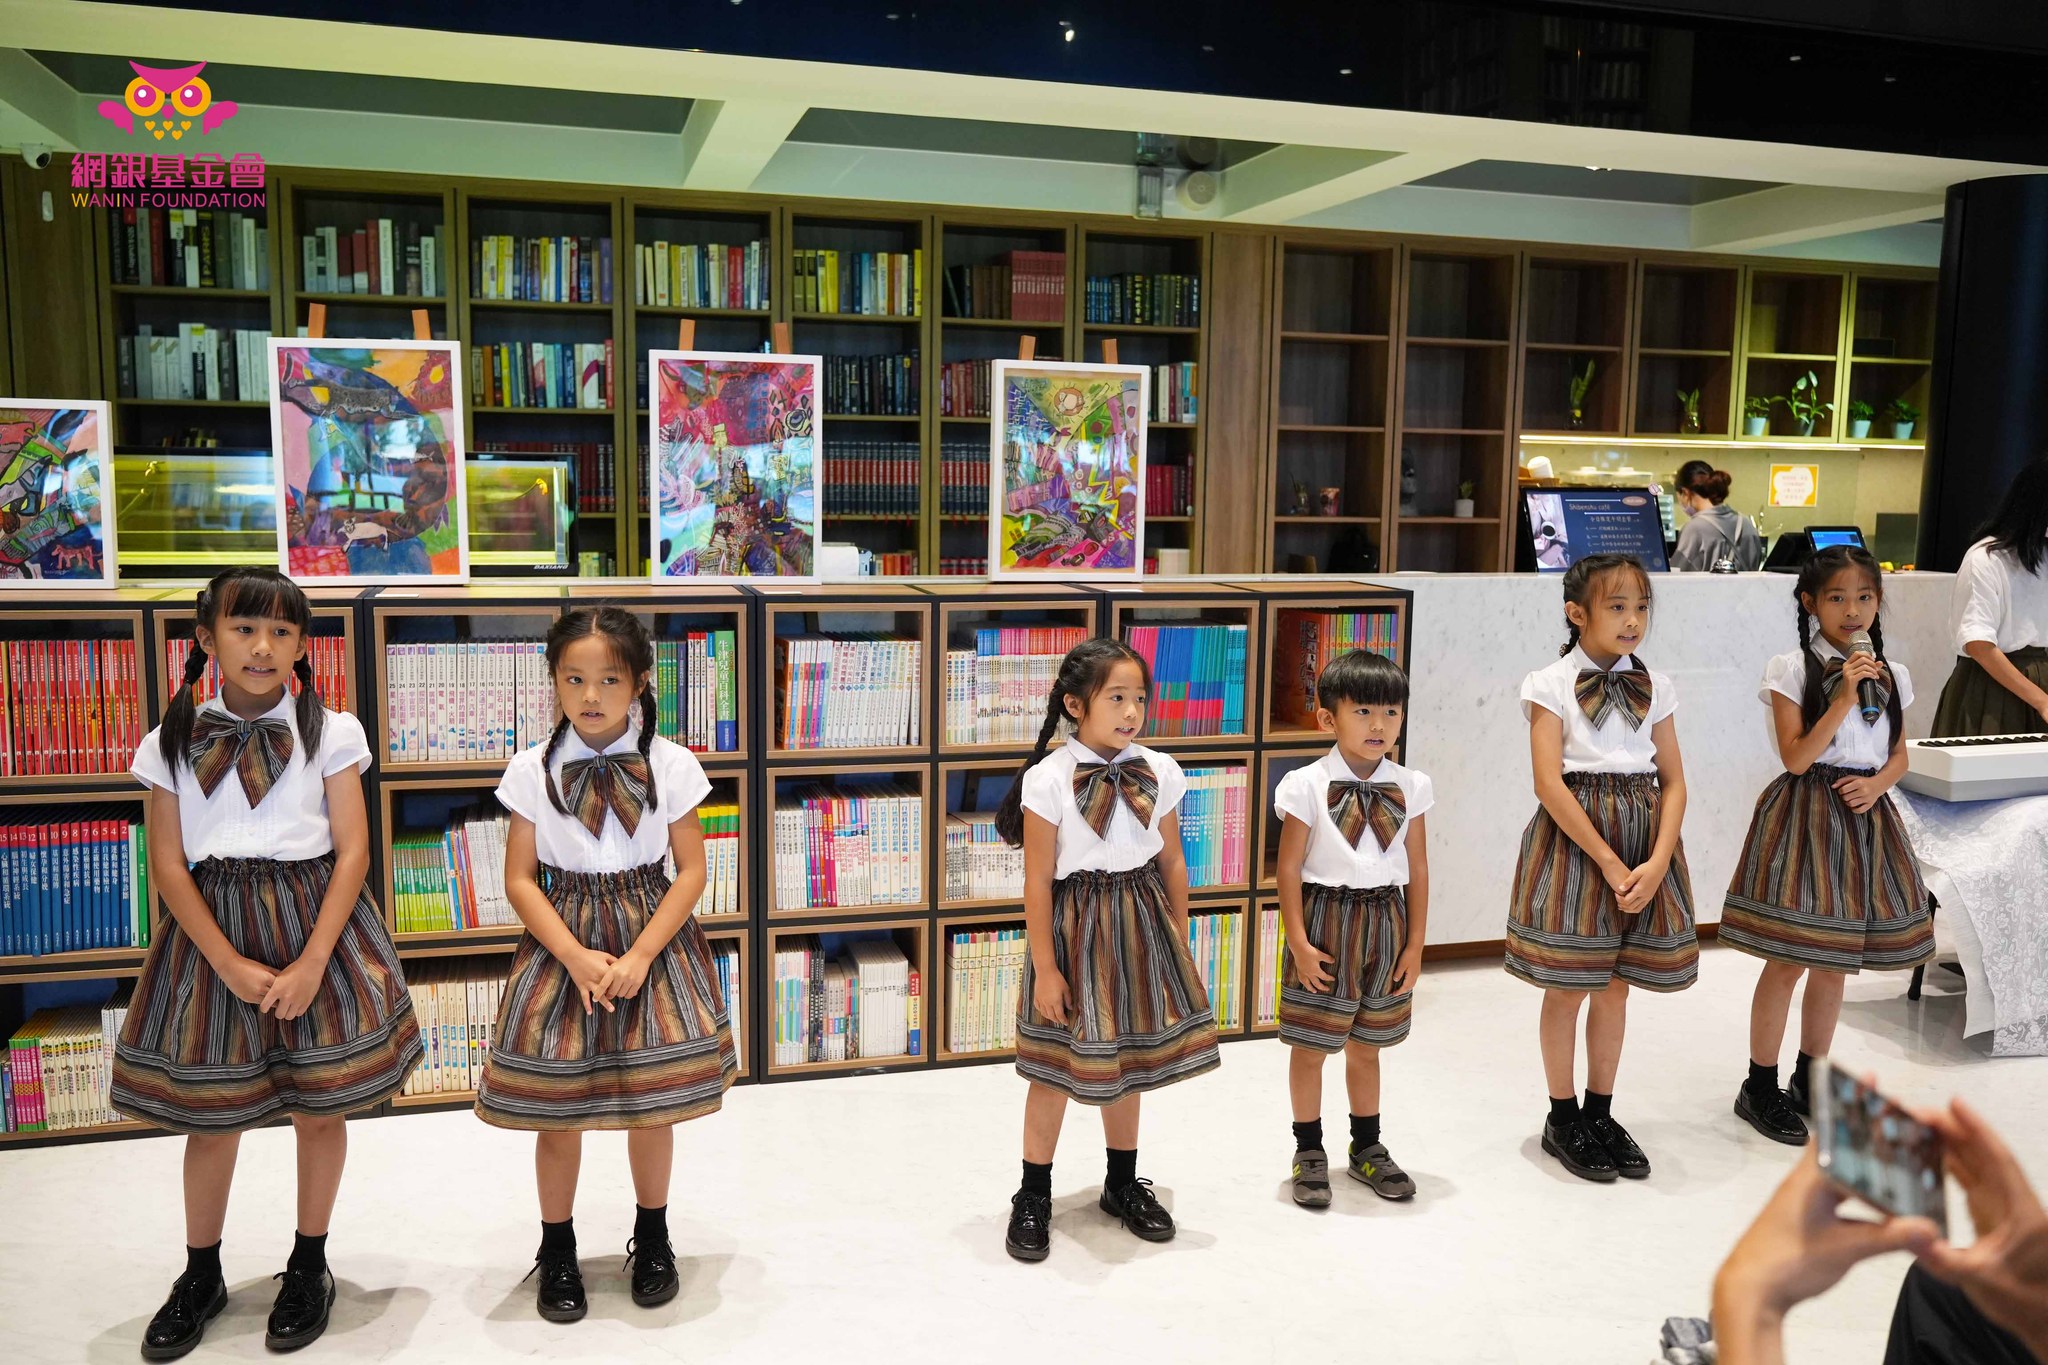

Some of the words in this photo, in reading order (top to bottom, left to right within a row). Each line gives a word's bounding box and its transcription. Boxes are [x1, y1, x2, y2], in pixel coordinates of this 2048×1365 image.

[718, 639, 730, 721] 牛津兒童百科全書
[19, 832, 27, 840] 13
[1362, 1162, 1376, 1178] N
